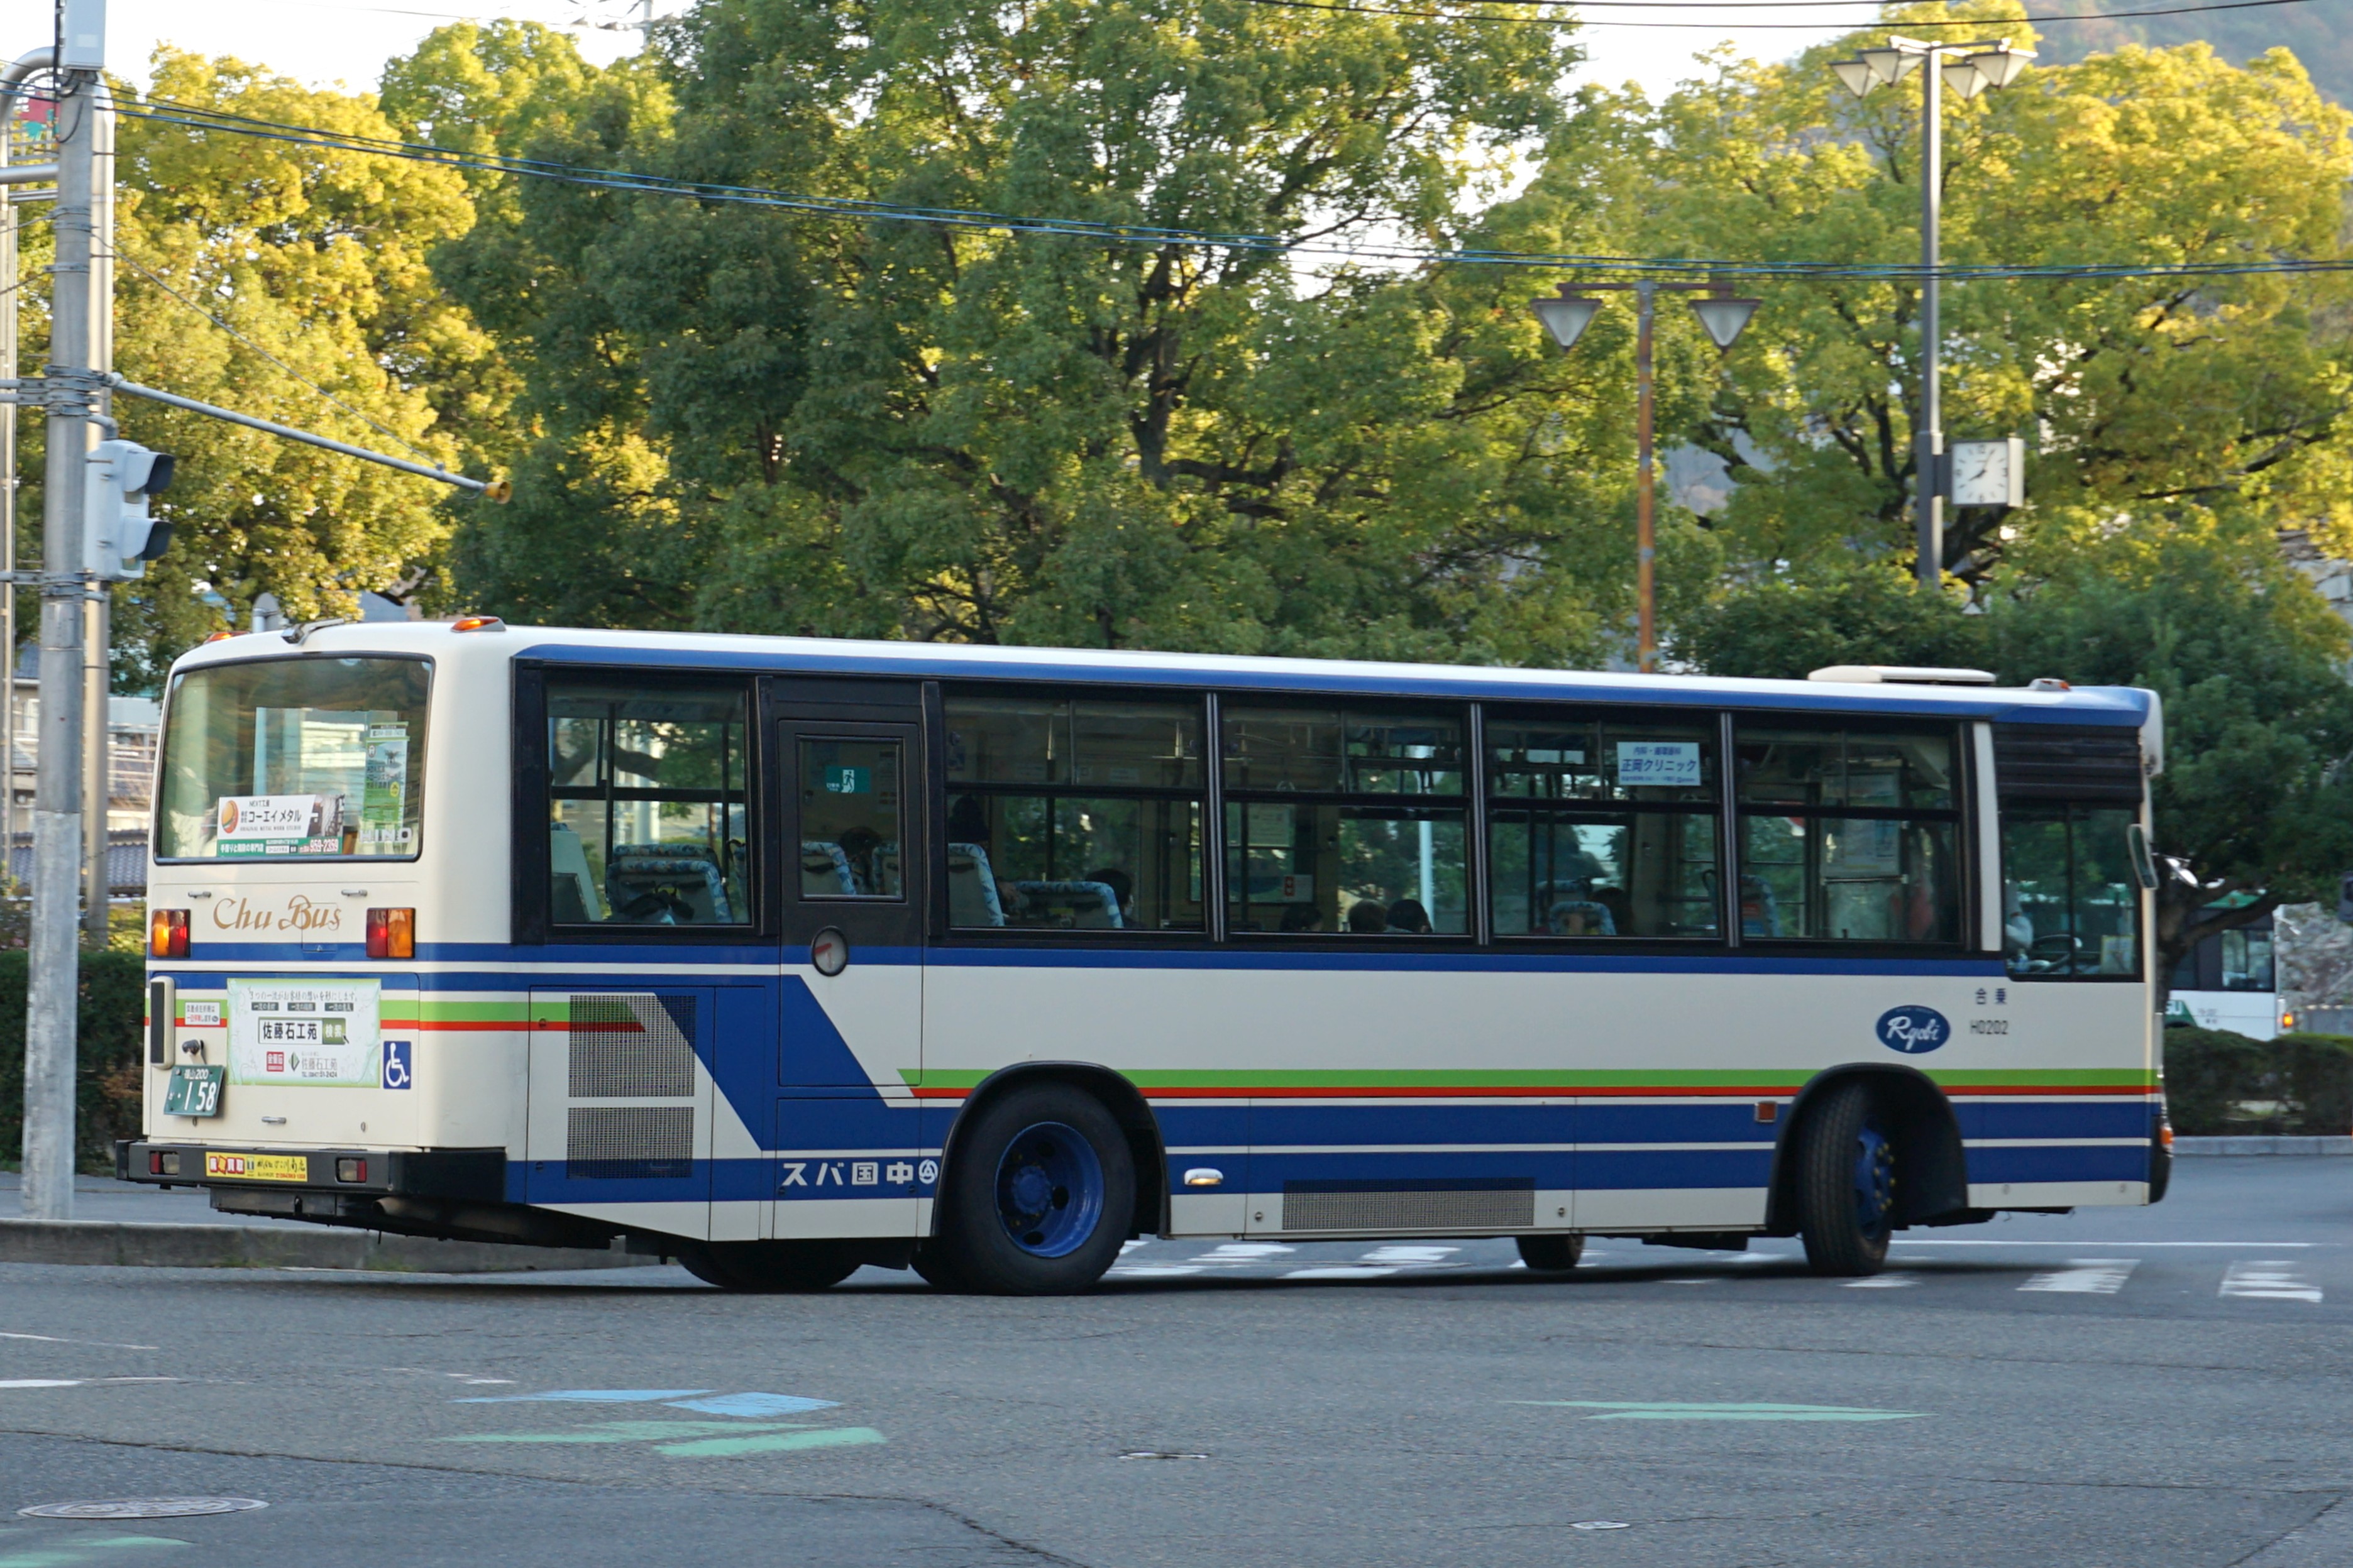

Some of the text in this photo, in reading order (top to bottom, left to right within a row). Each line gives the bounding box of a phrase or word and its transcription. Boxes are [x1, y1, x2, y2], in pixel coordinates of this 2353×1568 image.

[248, 809, 302, 823] コーエイメタル
[359, 827, 412, 843] HINO
[213, 894, 341, 931] Chu Bus
[263, 1021, 317, 1041] 佐藤石工苑
